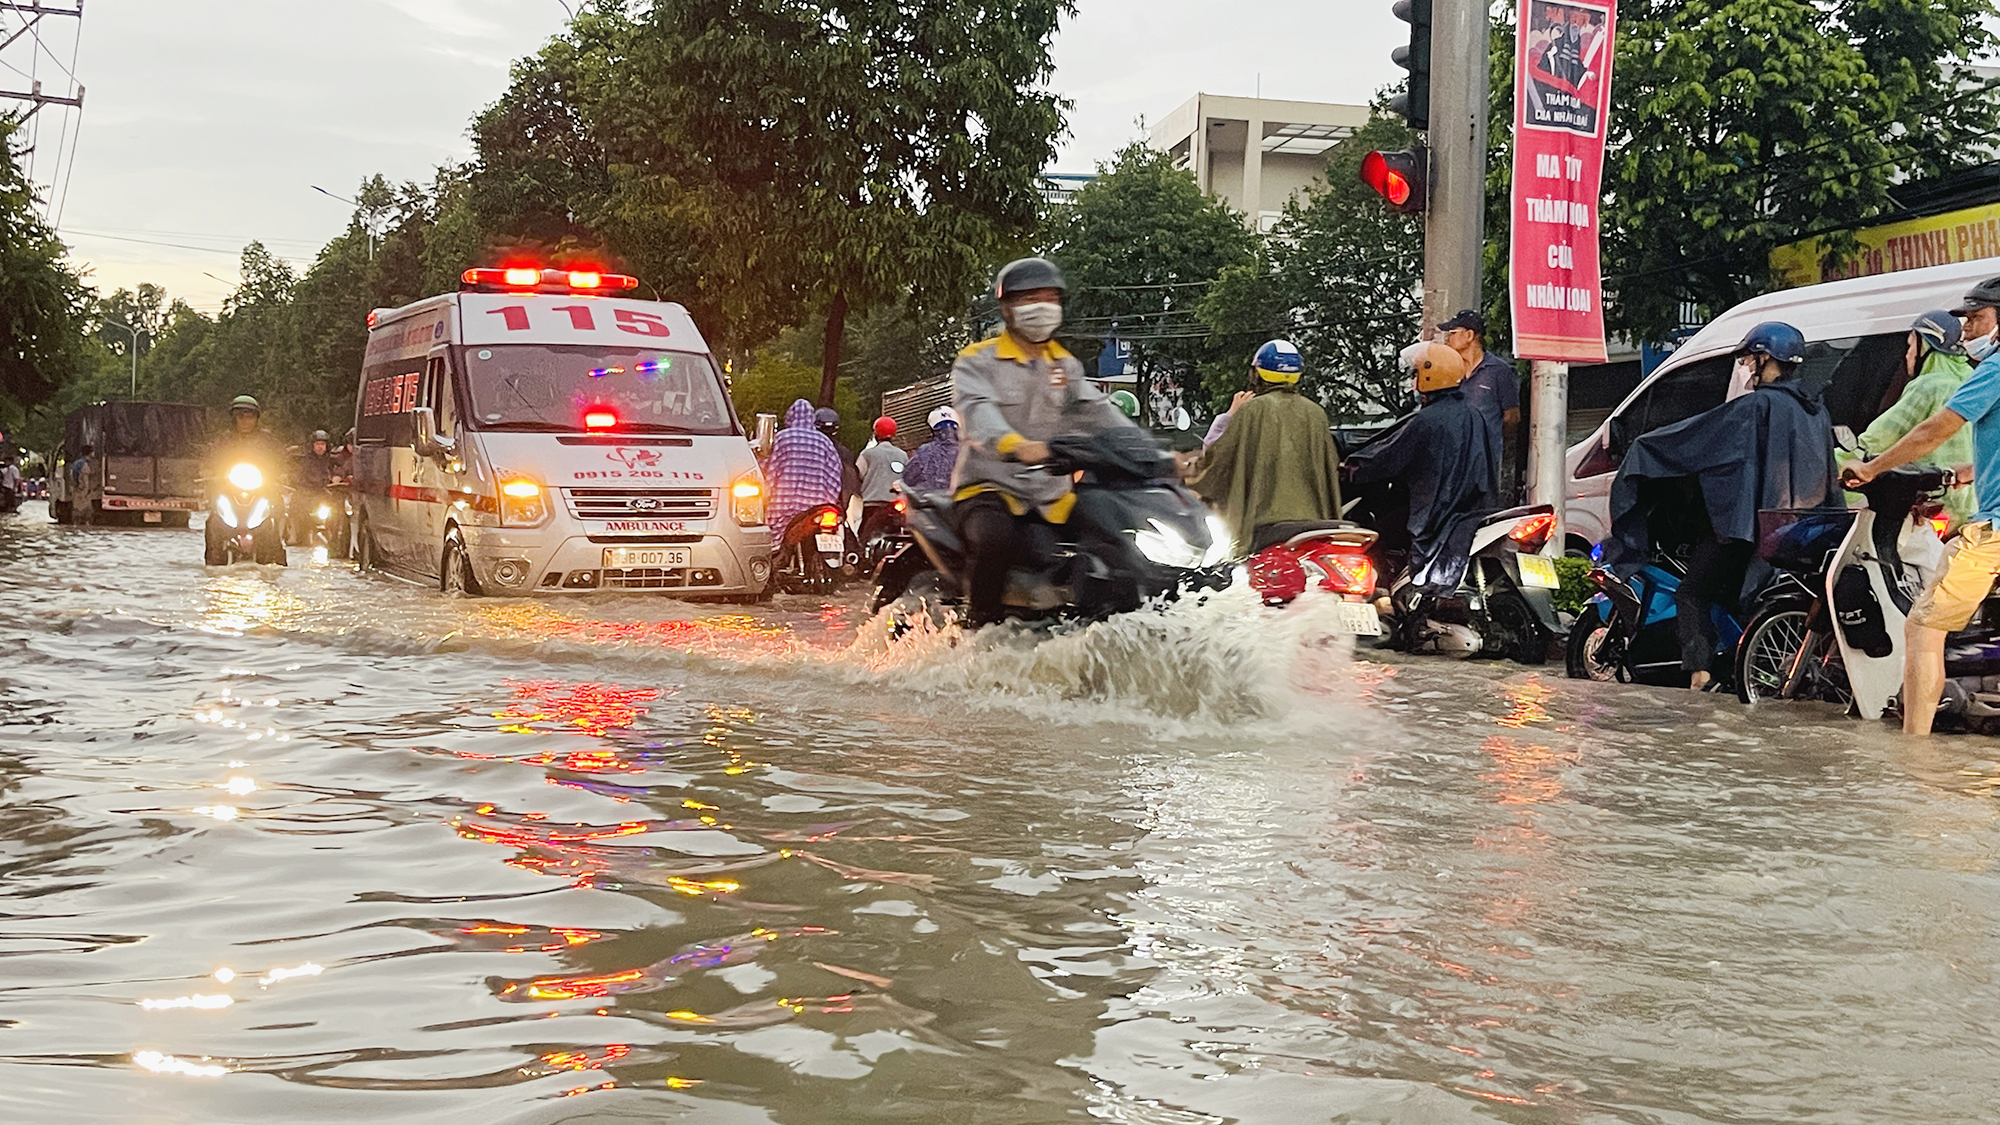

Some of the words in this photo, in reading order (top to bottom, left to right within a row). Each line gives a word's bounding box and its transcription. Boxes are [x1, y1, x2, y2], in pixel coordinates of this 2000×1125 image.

[1536, 153, 1560, 179] MA
[1565, 154, 1582, 182] TÚY
[1526, 194, 1568, 223] THẢM
[1569, 202, 1589, 231] HỌA
[1547, 240, 1573, 270] CỦA
[1526, 282, 1565, 310] NHÂN
[1567, 287, 1591, 316] LOẠI
[486, 306, 670, 337] 115
[574, 471, 622, 479] 0915
[671, 472, 703, 480] 115
[635, 499, 657, 509] Ford
[605, 522, 687, 531] AMBULANCE
